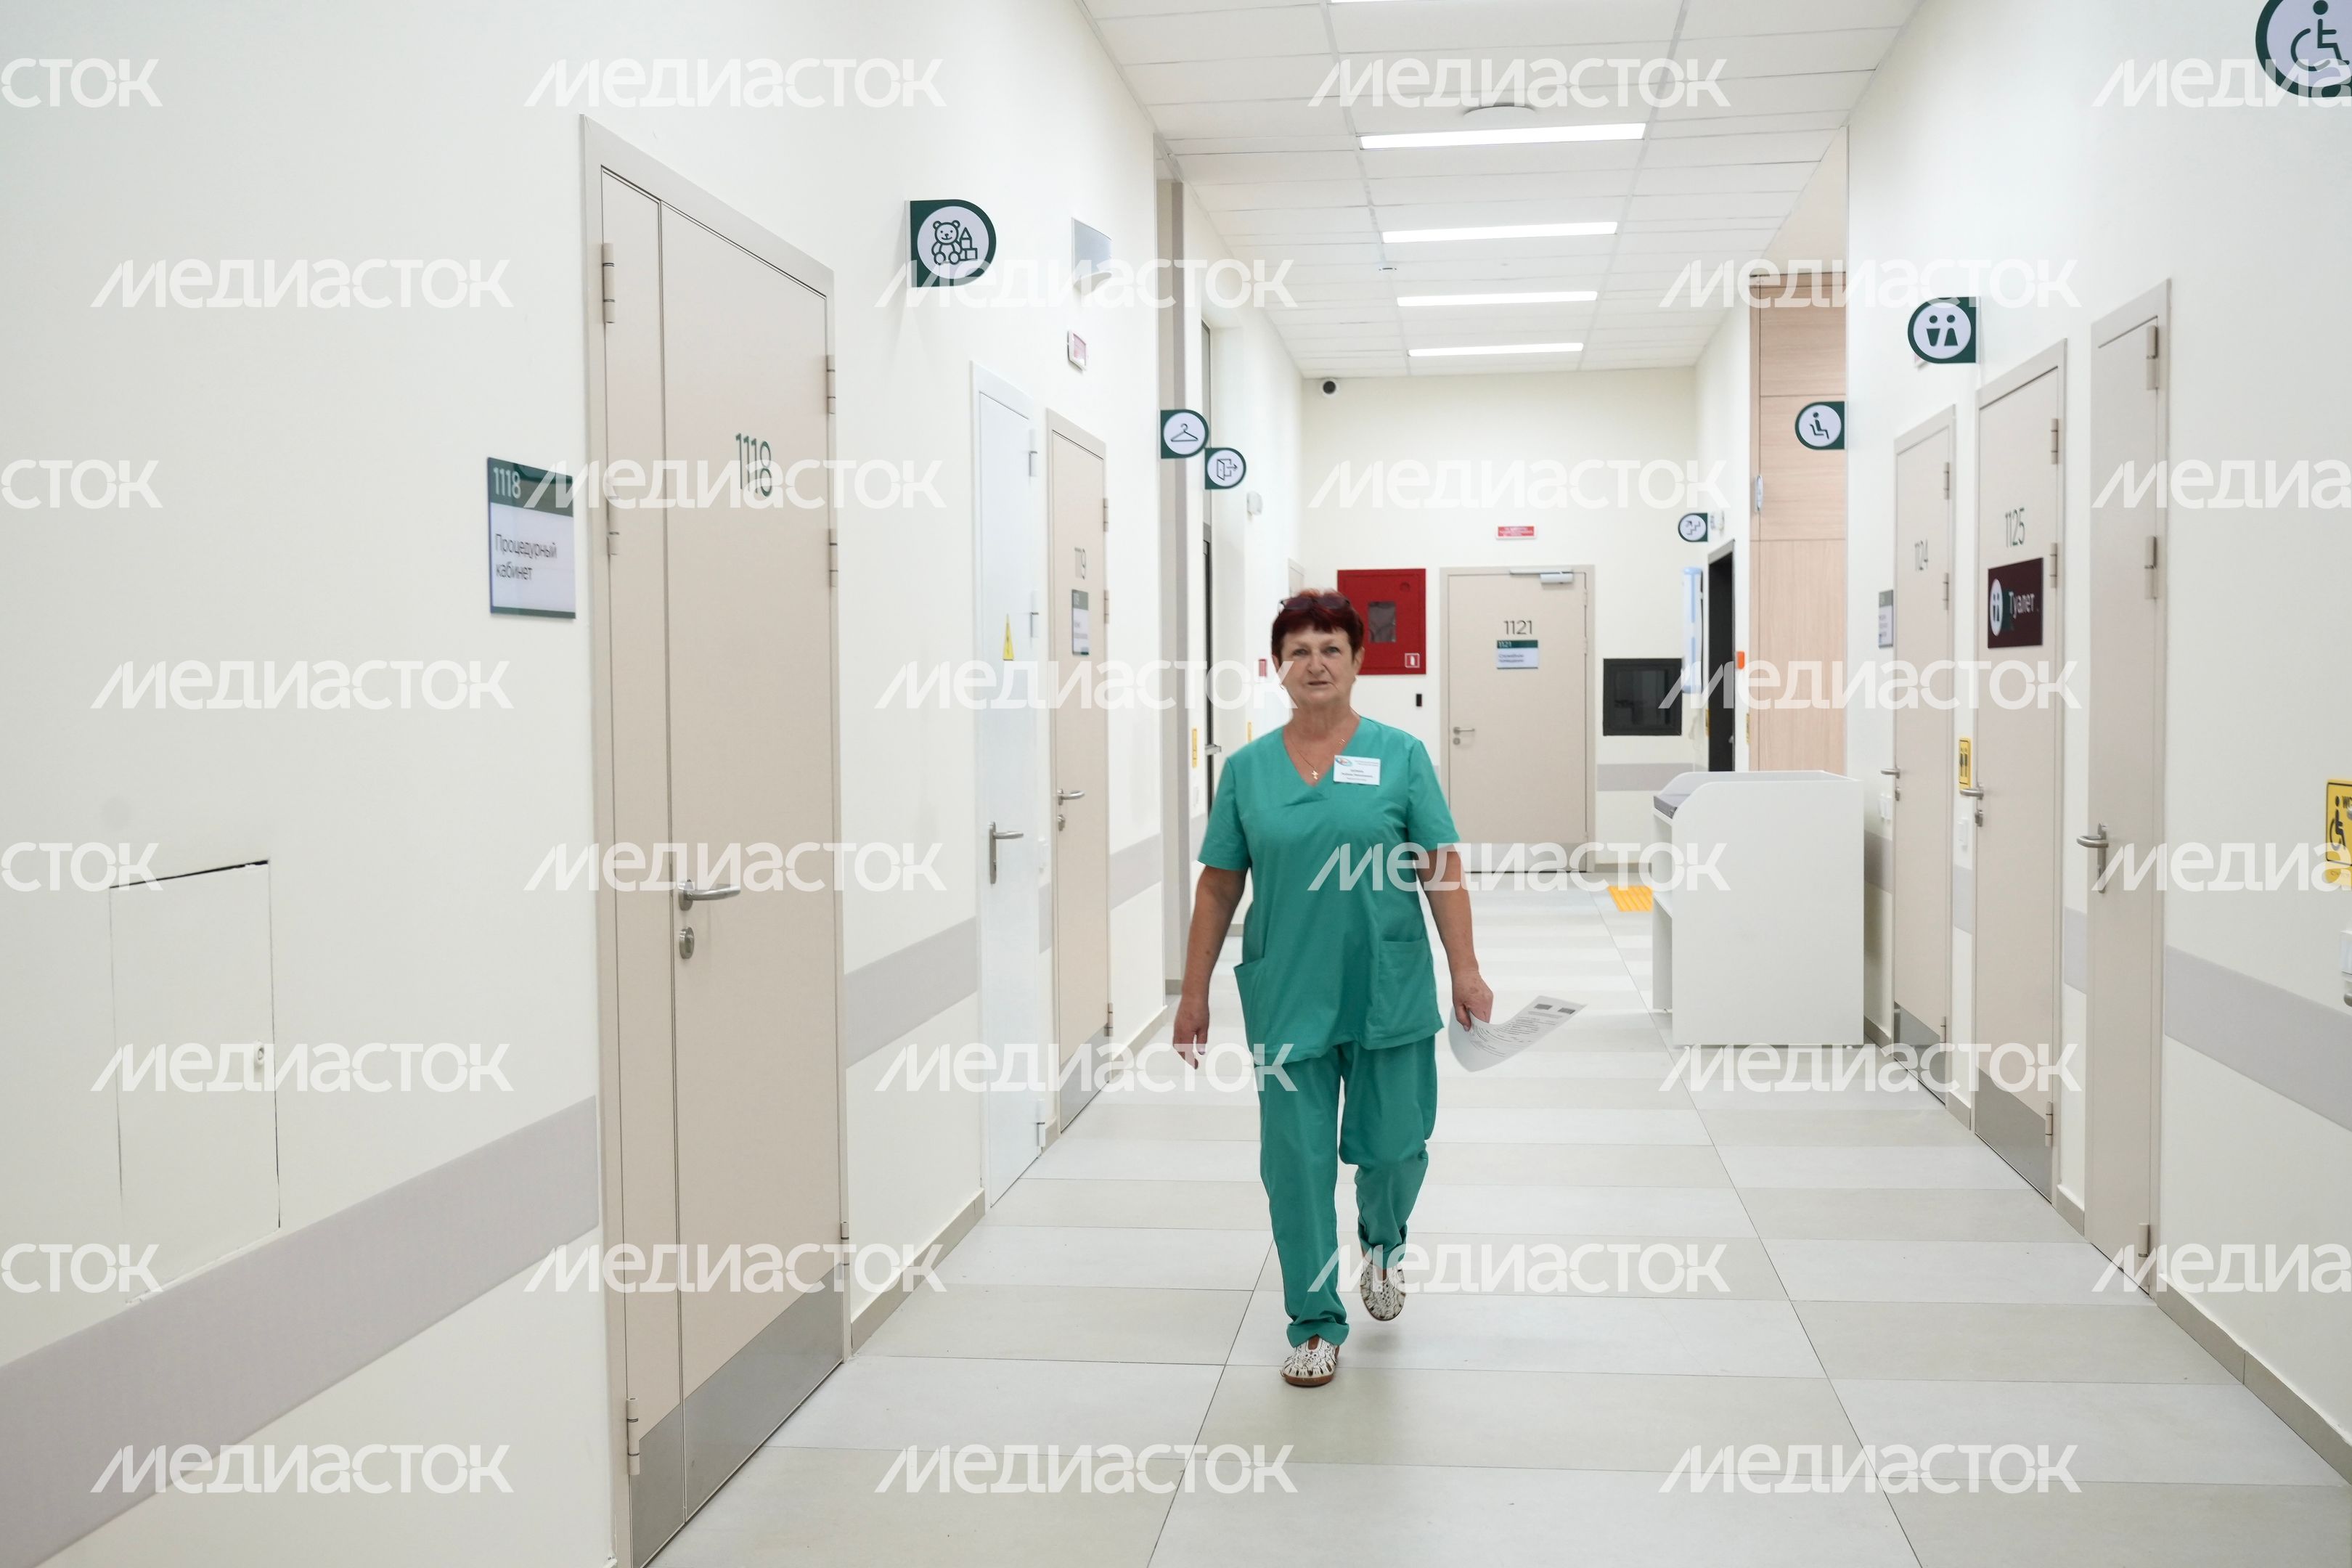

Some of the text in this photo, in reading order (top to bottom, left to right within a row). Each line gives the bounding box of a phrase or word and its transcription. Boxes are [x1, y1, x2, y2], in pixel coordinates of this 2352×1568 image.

[735, 433, 772, 497] 1118
[494, 467, 521, 499] 1118
[2005, 507, 2025, 547] 1125
[495, 534, 558, 560] Процедурный
[496, 561, 533, 580] кабинет
[2009, 591, 2035, 618] Туалет
[1503, 620, 1532, 635] 1121
